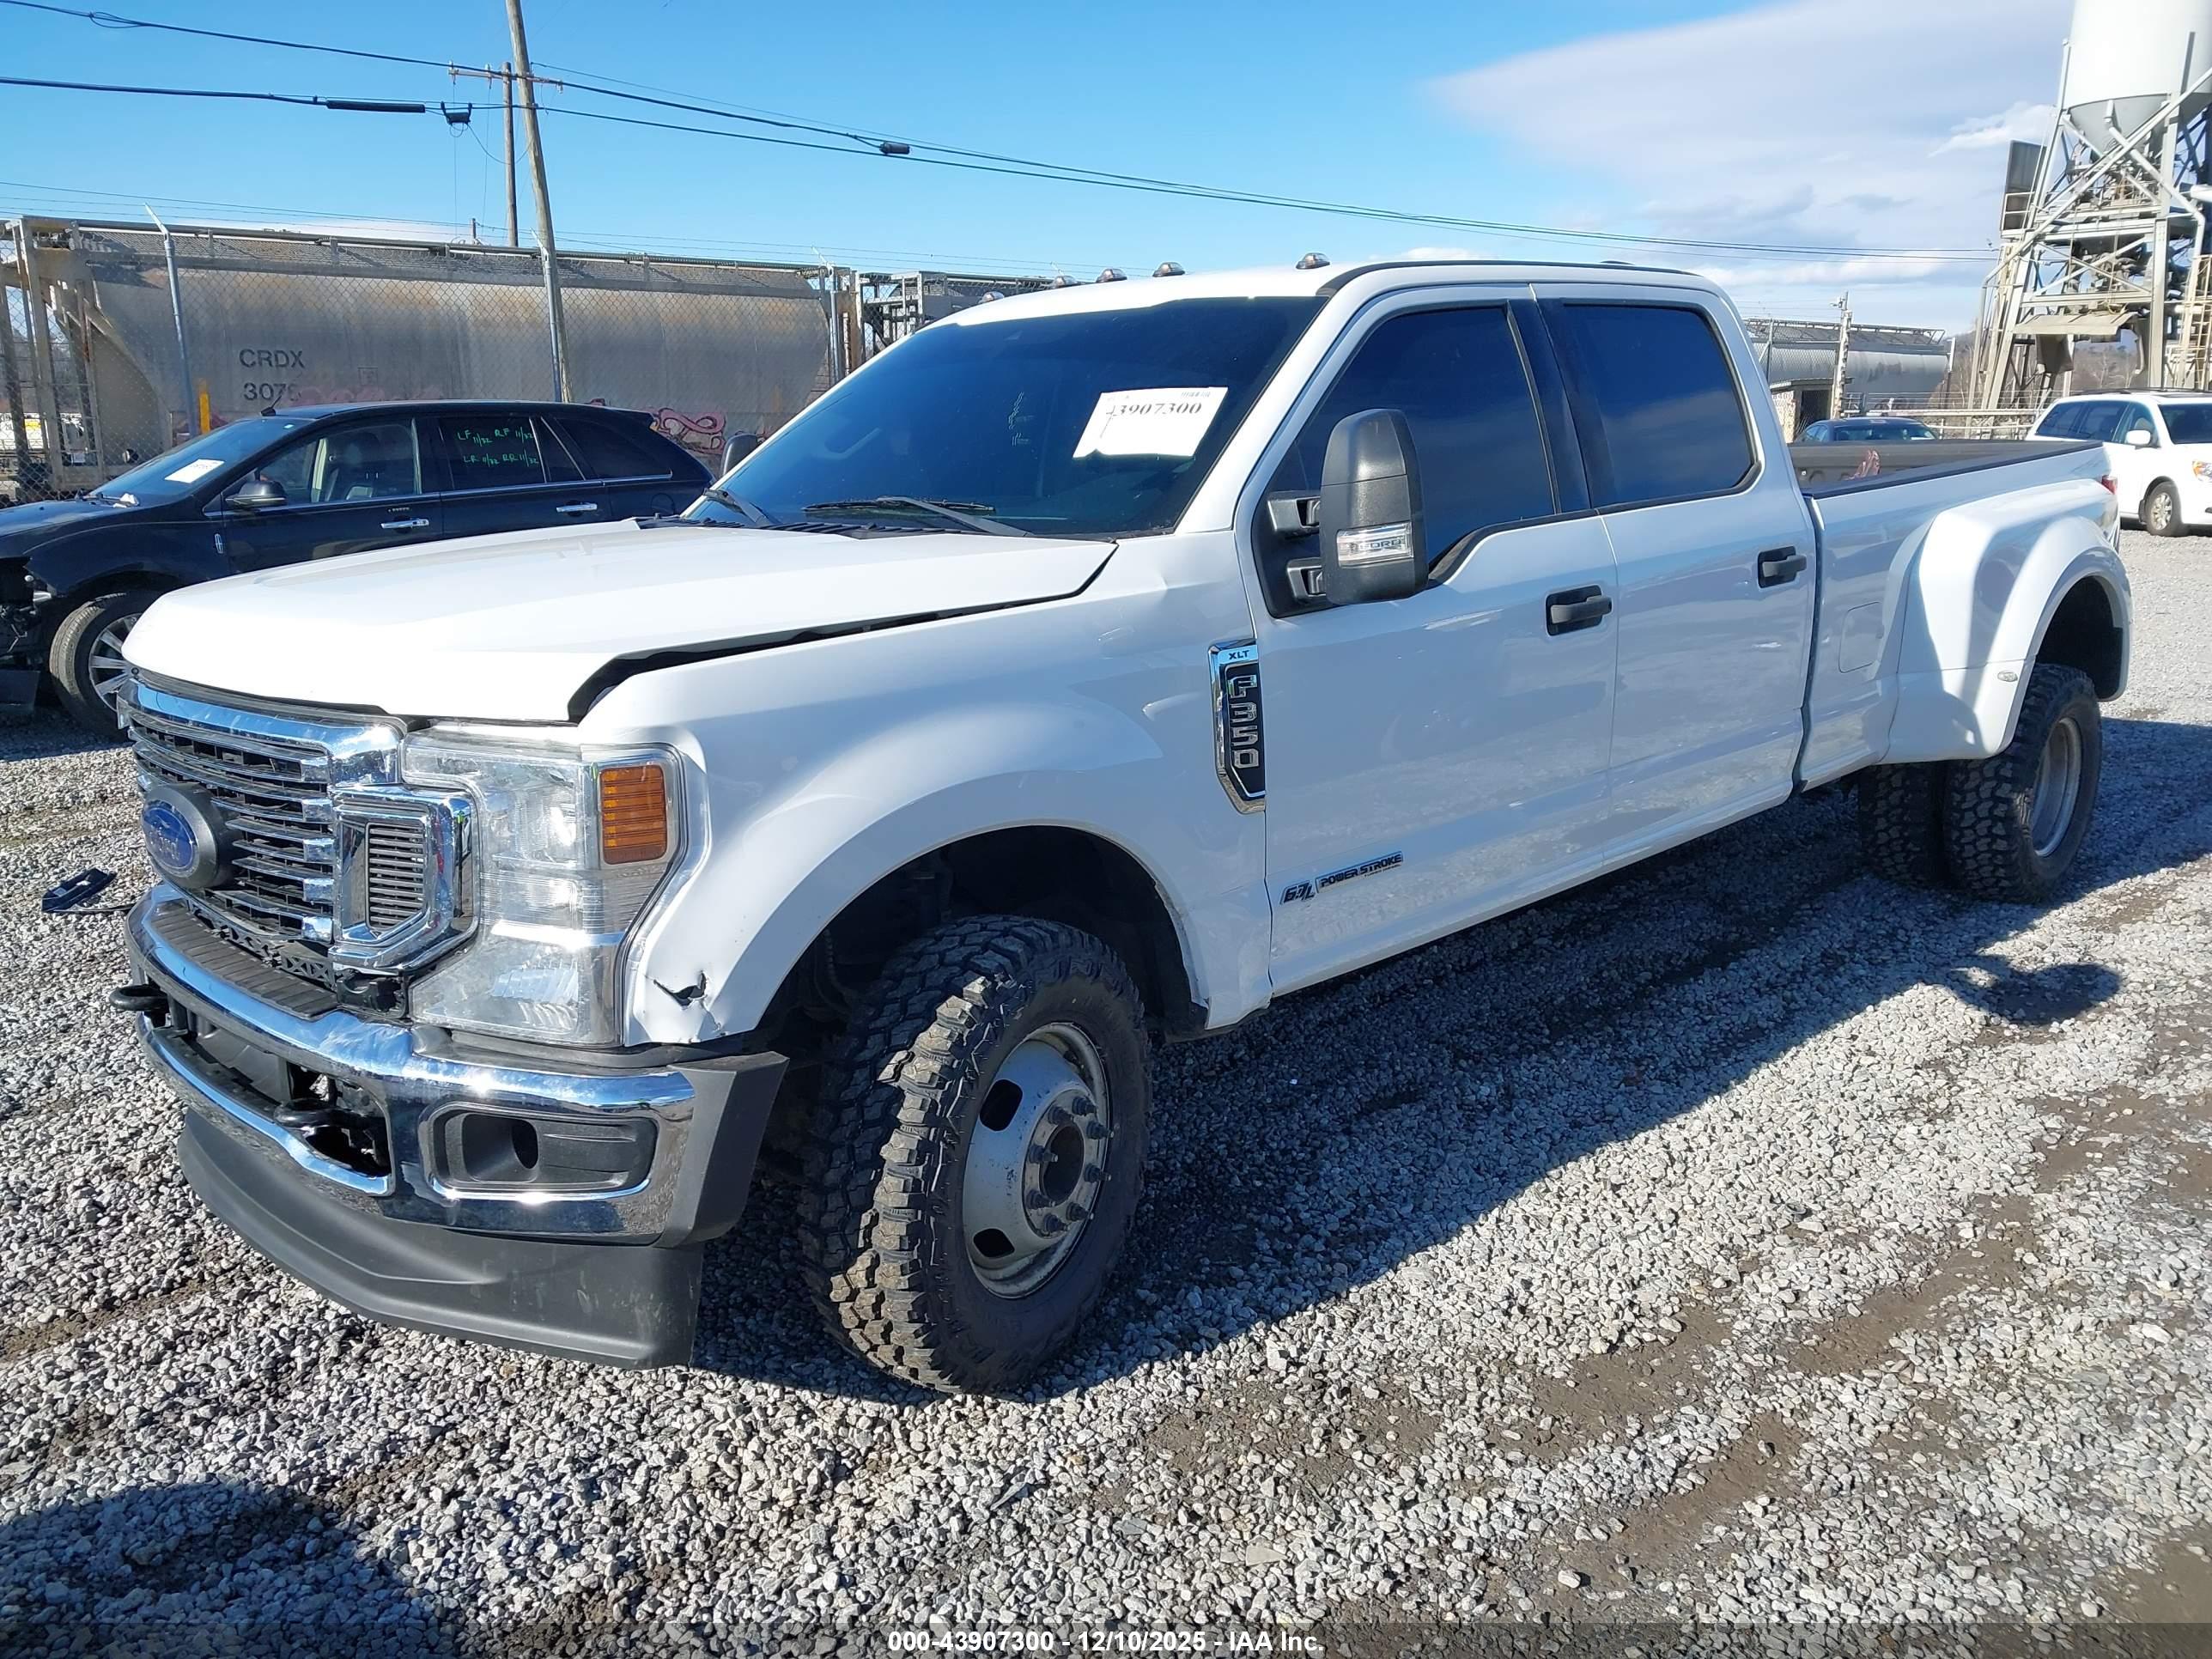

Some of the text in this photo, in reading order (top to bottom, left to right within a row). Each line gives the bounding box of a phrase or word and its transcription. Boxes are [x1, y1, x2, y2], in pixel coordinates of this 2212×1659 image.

[239, 348, 305, 368] CRDX
[457, 429, 471, 441] LF
[1228, 649, 1250, 660] XLT
[1227, 674, 1261, 769] F350
[1321, 869, 1358, 888] POWER
[1359, 854, 1402, 874] STROKE
